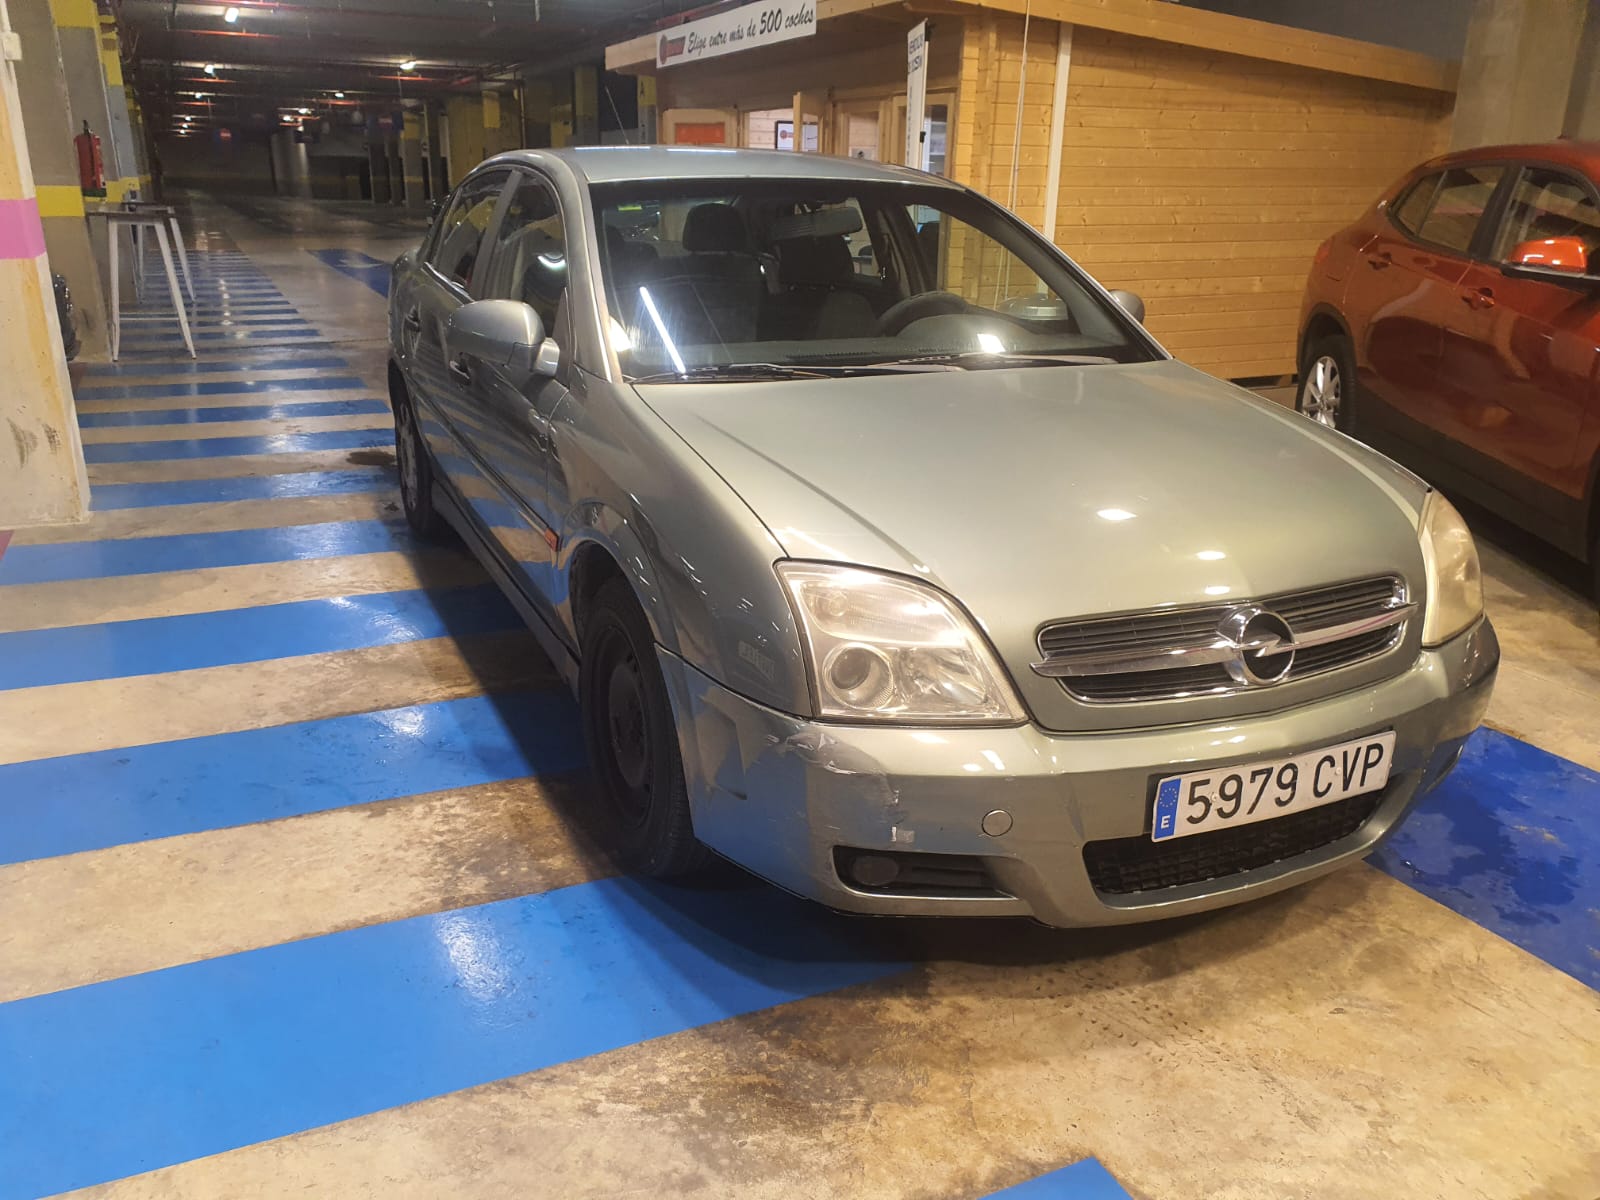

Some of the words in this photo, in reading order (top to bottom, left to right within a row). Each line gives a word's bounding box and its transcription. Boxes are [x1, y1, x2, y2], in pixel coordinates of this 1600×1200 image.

[687, 31, 706, 55] Elige
[709, 33, 727, 48] entre
[729, 26, 744, 41] más
[747, 19, 756, 37] de
[759, 8, 783, 34] 500
[785, 2, 814, 29] coches
[1186, 762, 1299, 824] 5979
[1312, 742, 1384, 798] CVP
[1160, 815, 1171, 829] E
